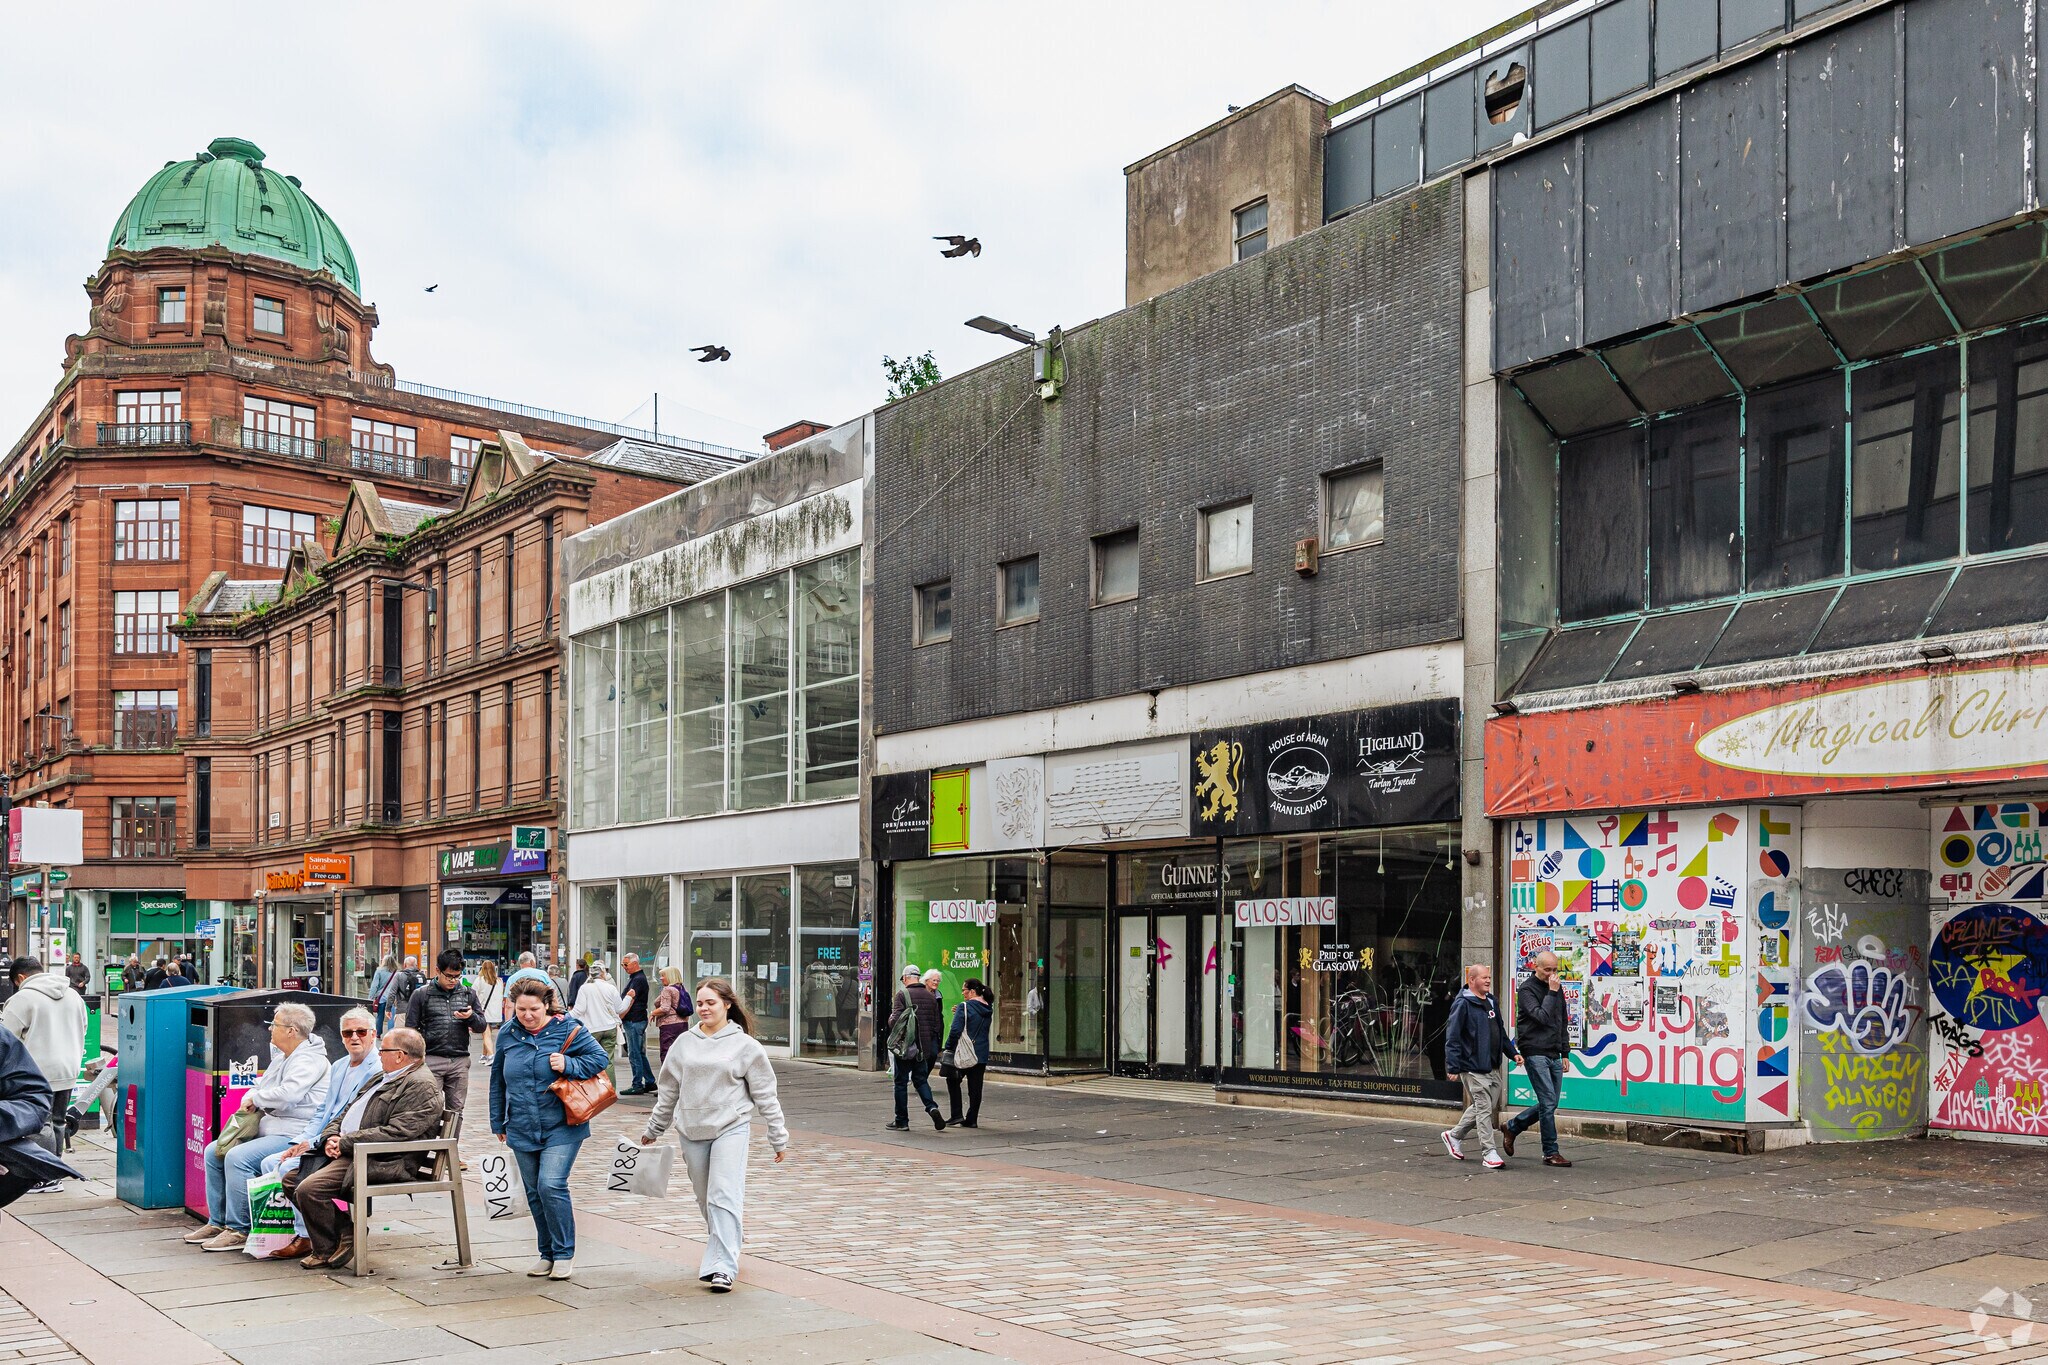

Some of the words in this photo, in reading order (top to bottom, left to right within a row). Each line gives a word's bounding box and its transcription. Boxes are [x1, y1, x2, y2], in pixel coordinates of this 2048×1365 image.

[1763, 692, 1945, 766] Magical
[1268, 733, 1296, 754] HOUSE
[1296, 732, 1306, 742] of
[1306, 732, 1329, 748] ARAN
[1358, 731, 1425, 757] HIGHLAND
[1368, 776, 1392, 789] Tartan
[1393, 773, 1417, 788] Tweeds
[1269, 799, 1293, 816] ARAN
[1293, 795, 1328, 816] ISLANDS
[899, 819, 930, 827] MORRISON
[309, 856, 346, 864] Sainsbury's
[1161, 863, 1231, 886] GUINNES
[1151, 892, 1174, 900] OFFICIAL
[1174, 890, 1212, 899] MERCHANDISE
[1227, 889, 1242, 897] HERE
[140, 901, 178, 910] Specsavers
[930, 901, 996, 923] CLOSING
[1237, 898, 1335, 923] CLOSING
[1697, 937, 1717, 946] BELONG
[1698, 929, 1716, 938] PEOPLE
[817, 947, 841, 960] FREE
[1519, 936, 1551, 957] CIRCUS
[1700, 946, 1713, 955] HERE
[1342, 951, 1354, 960] OF
[950, 959, 980, 969] GLASGOW
[1312, 960, 1360, 972] GLASGOW
[1620, 1030, 1745, 1104] ping
[85, 1072, 114, 1104] nextbike
[1248, 1073, 1290, 1084] WORLDWIDE
[1291, 1076, 1323, 1086] SHIPPING
[1328, 1078, 1362, 1089] TAX-FREE
[1363, 1081, 1400, 1092] SHOPPING
[1401, 1084, 1422, 1094] HERE
[191, 1113, 205, 1130] PEOPLE
[193, 1127, 204, 1143] MAKE
[186, 1139, 204, 1155] GLASGOW
[607, 1142, 641, 1192] M&S
[482, 1155, 514, 1220] M&S
